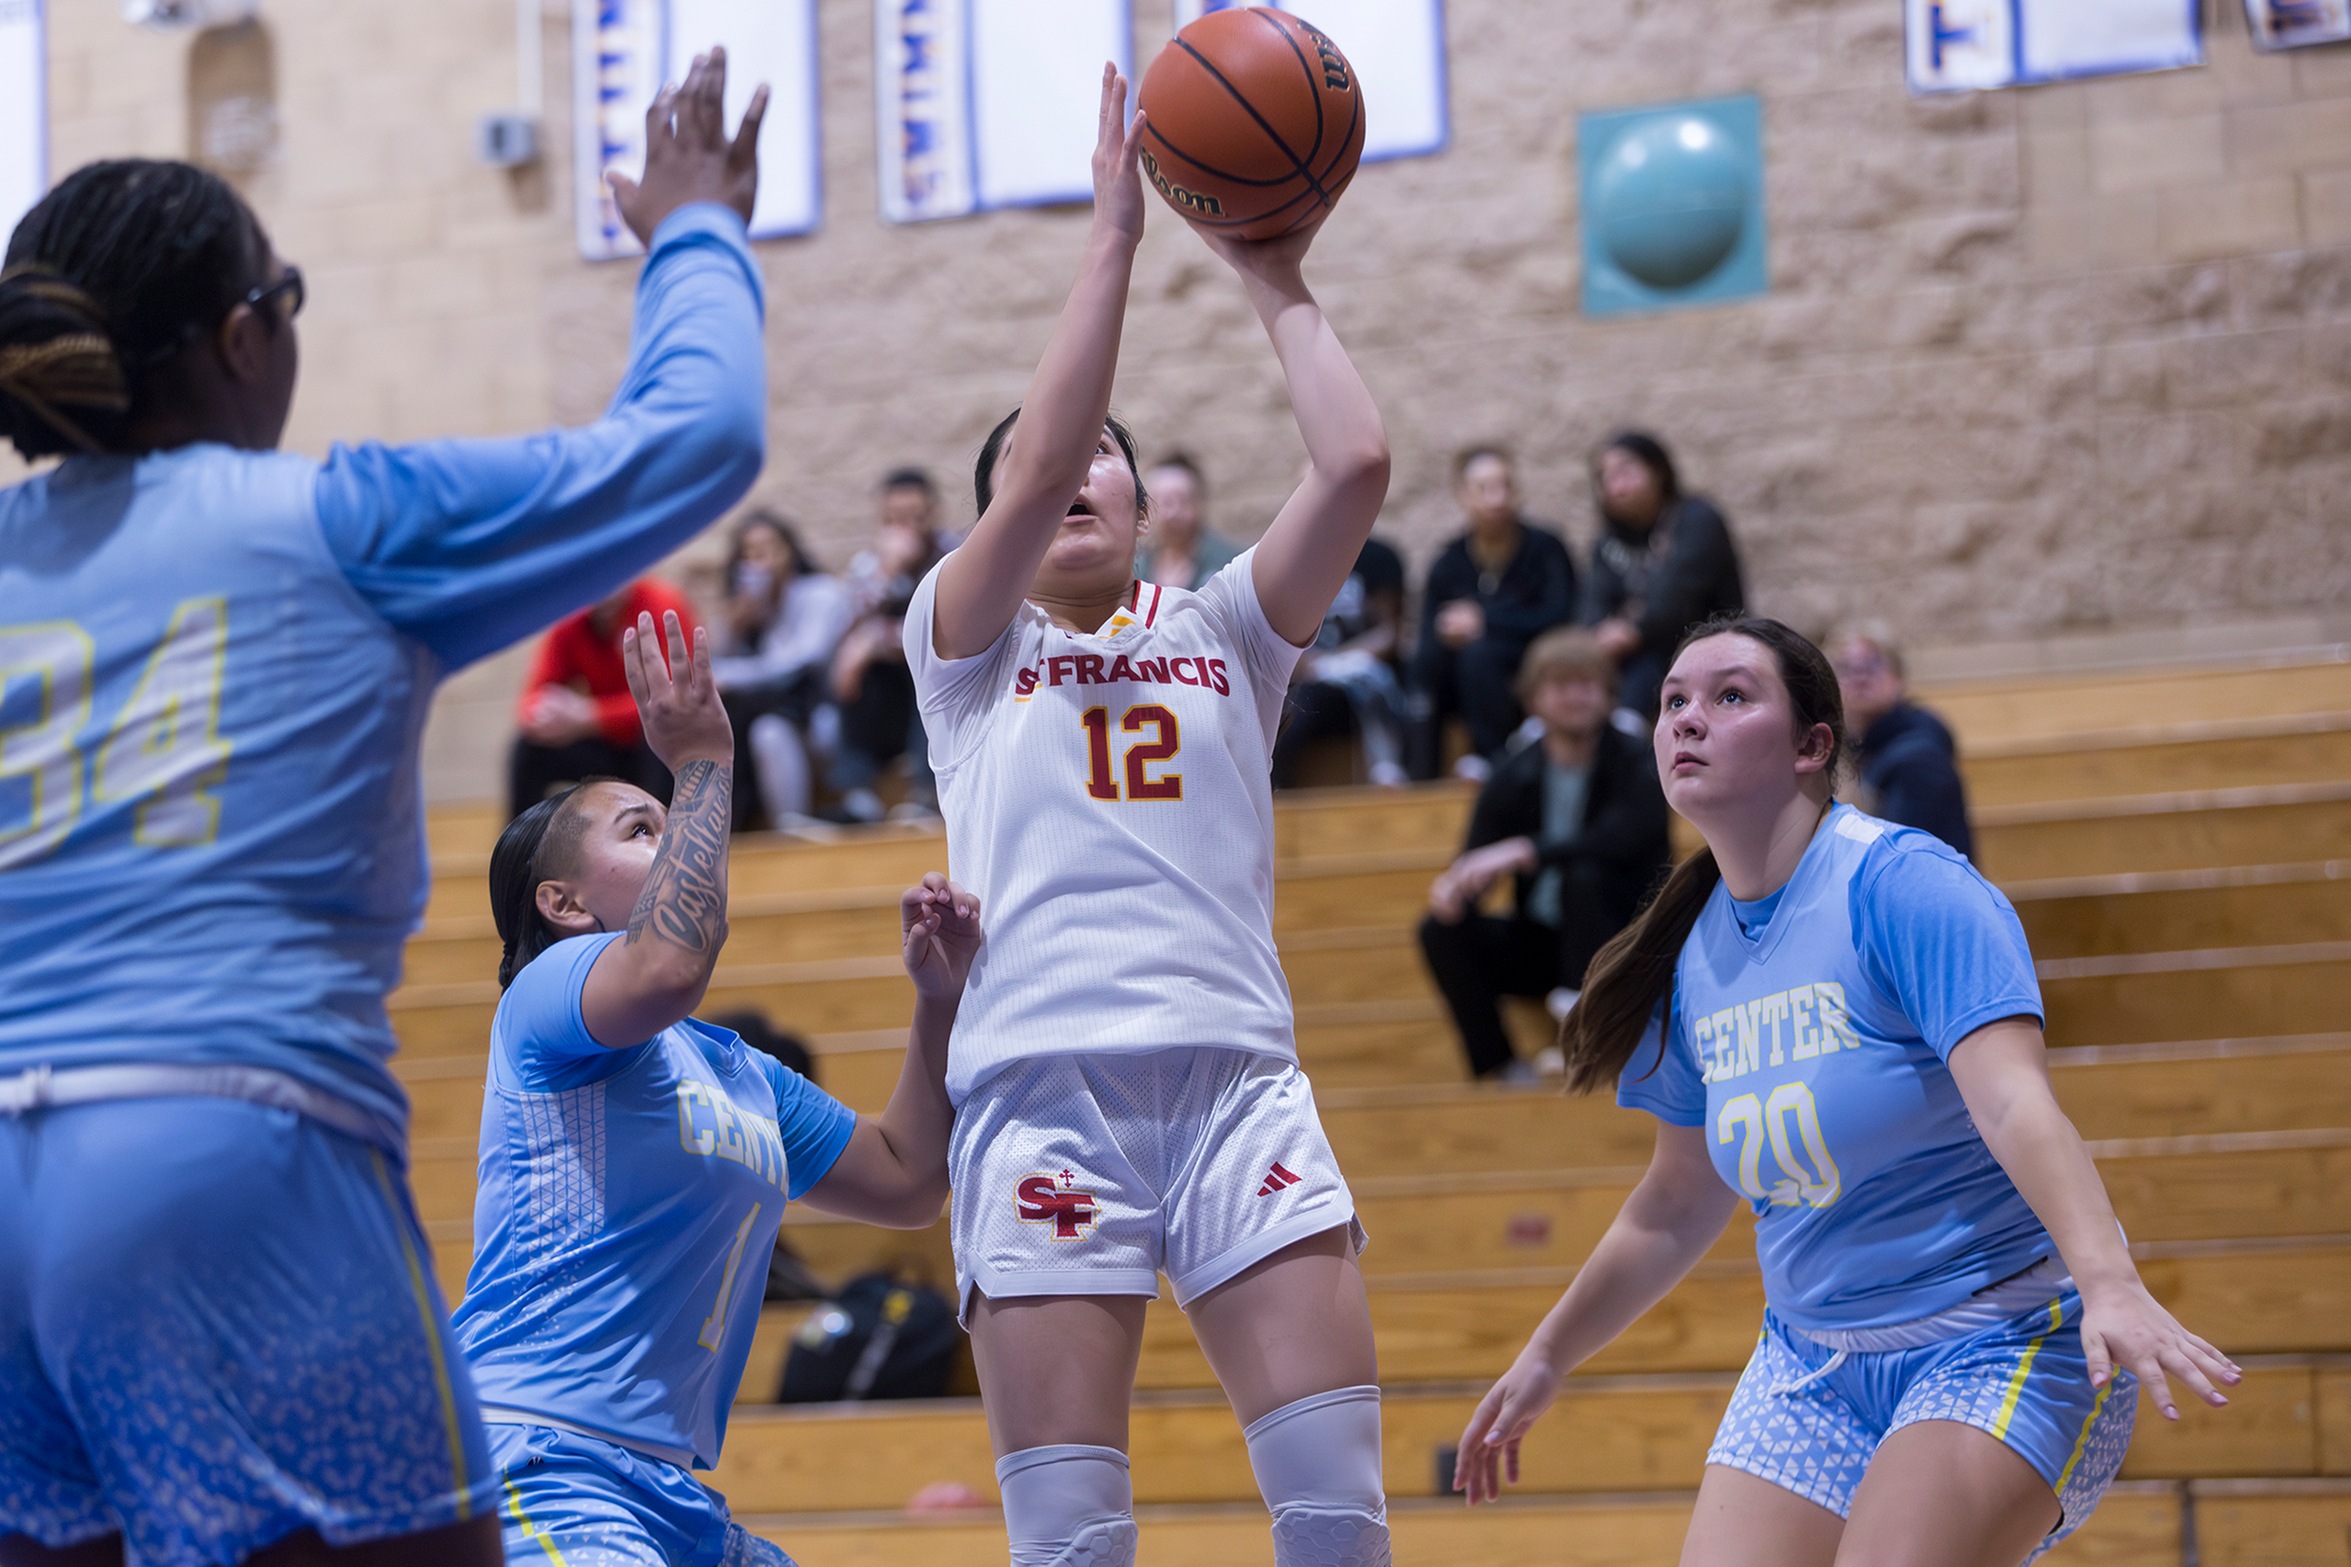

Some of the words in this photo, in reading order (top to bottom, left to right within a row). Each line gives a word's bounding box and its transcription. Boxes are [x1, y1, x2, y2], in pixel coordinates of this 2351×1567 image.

[1139, 146, 1223, 216] ilson
[1047, 653, 1231, 698] FRANCIS
[1080, 703, 1184, 802] 12
[1694, 981, 1861, 1086] CENTER
[1717, 1080, 1842, 1209] 20
[1014, 1173, 1101, 1242] SF
[697, 1201, 761, 1353] 1
